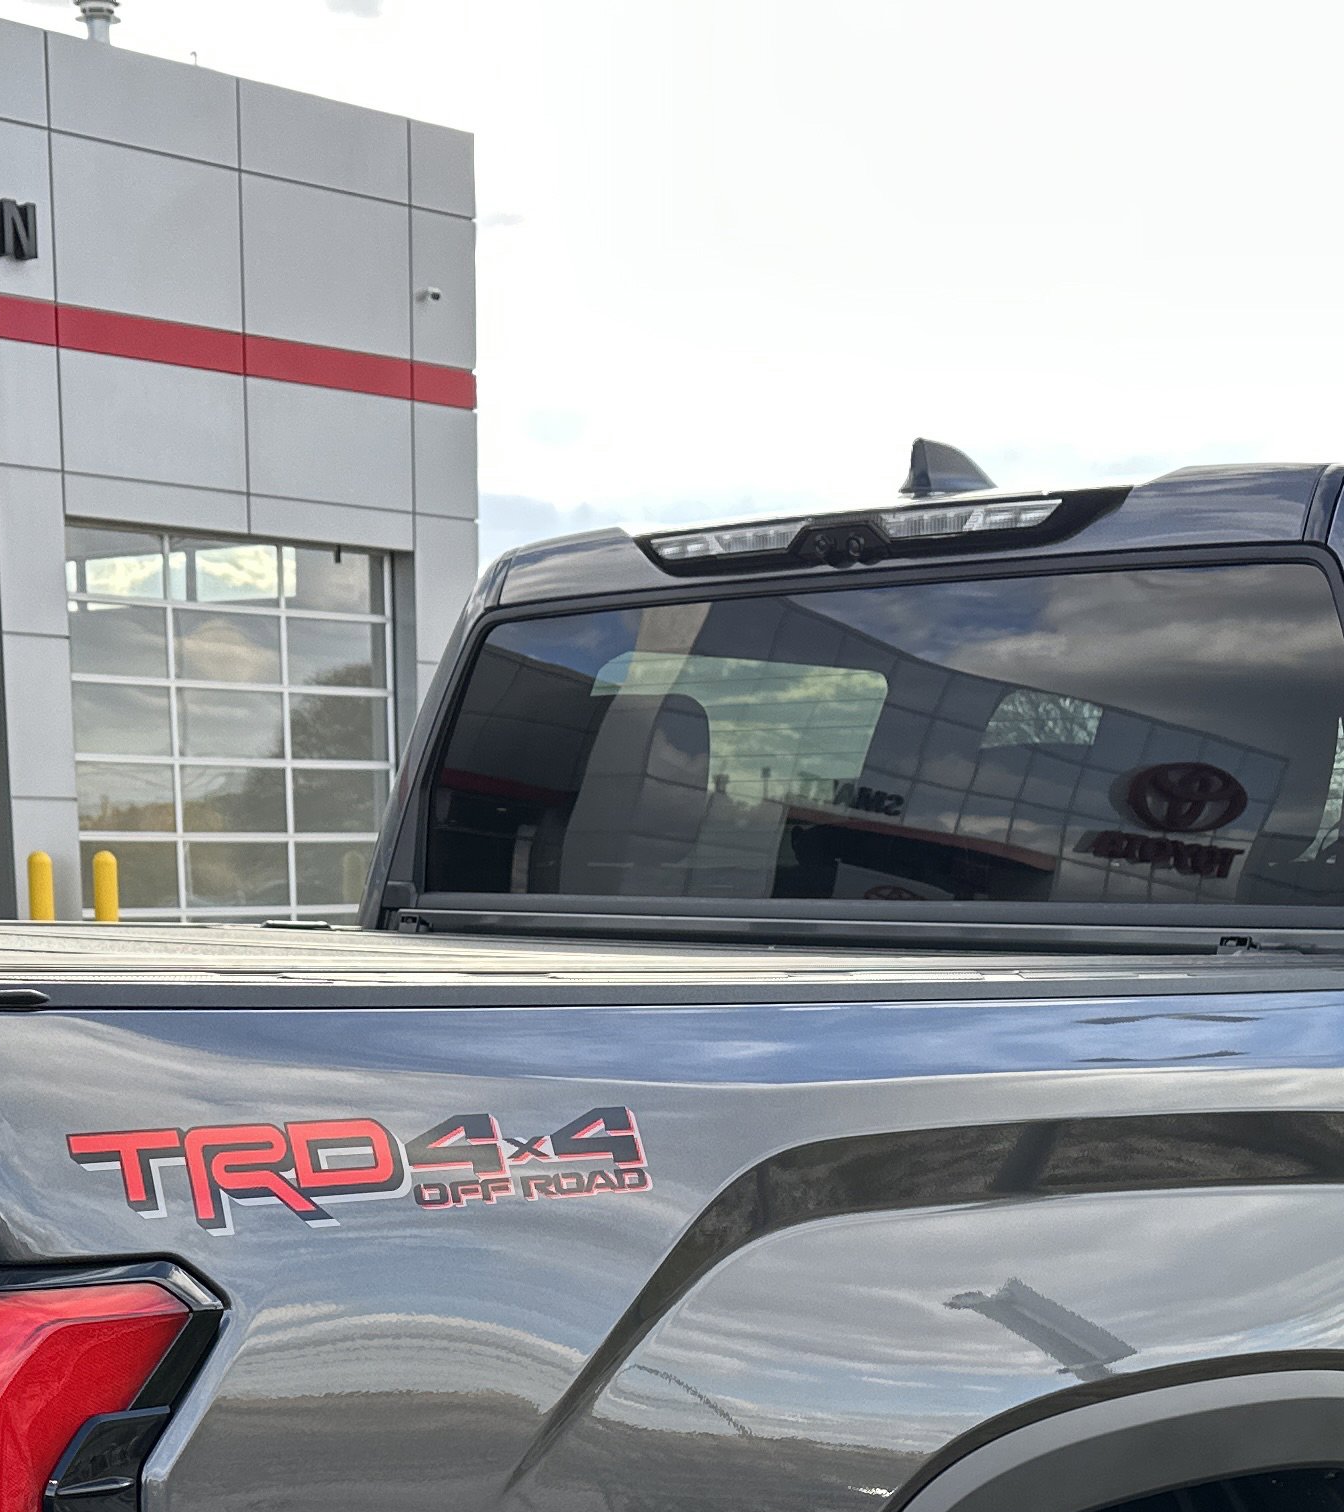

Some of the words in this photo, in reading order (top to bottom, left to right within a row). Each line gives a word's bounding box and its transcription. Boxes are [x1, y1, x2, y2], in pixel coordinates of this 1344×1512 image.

[65, 1117, 412, 1237] TRD
[413, 1175, 518, 1211] OFF
[520, 1166, 654, 1204] ROAD
